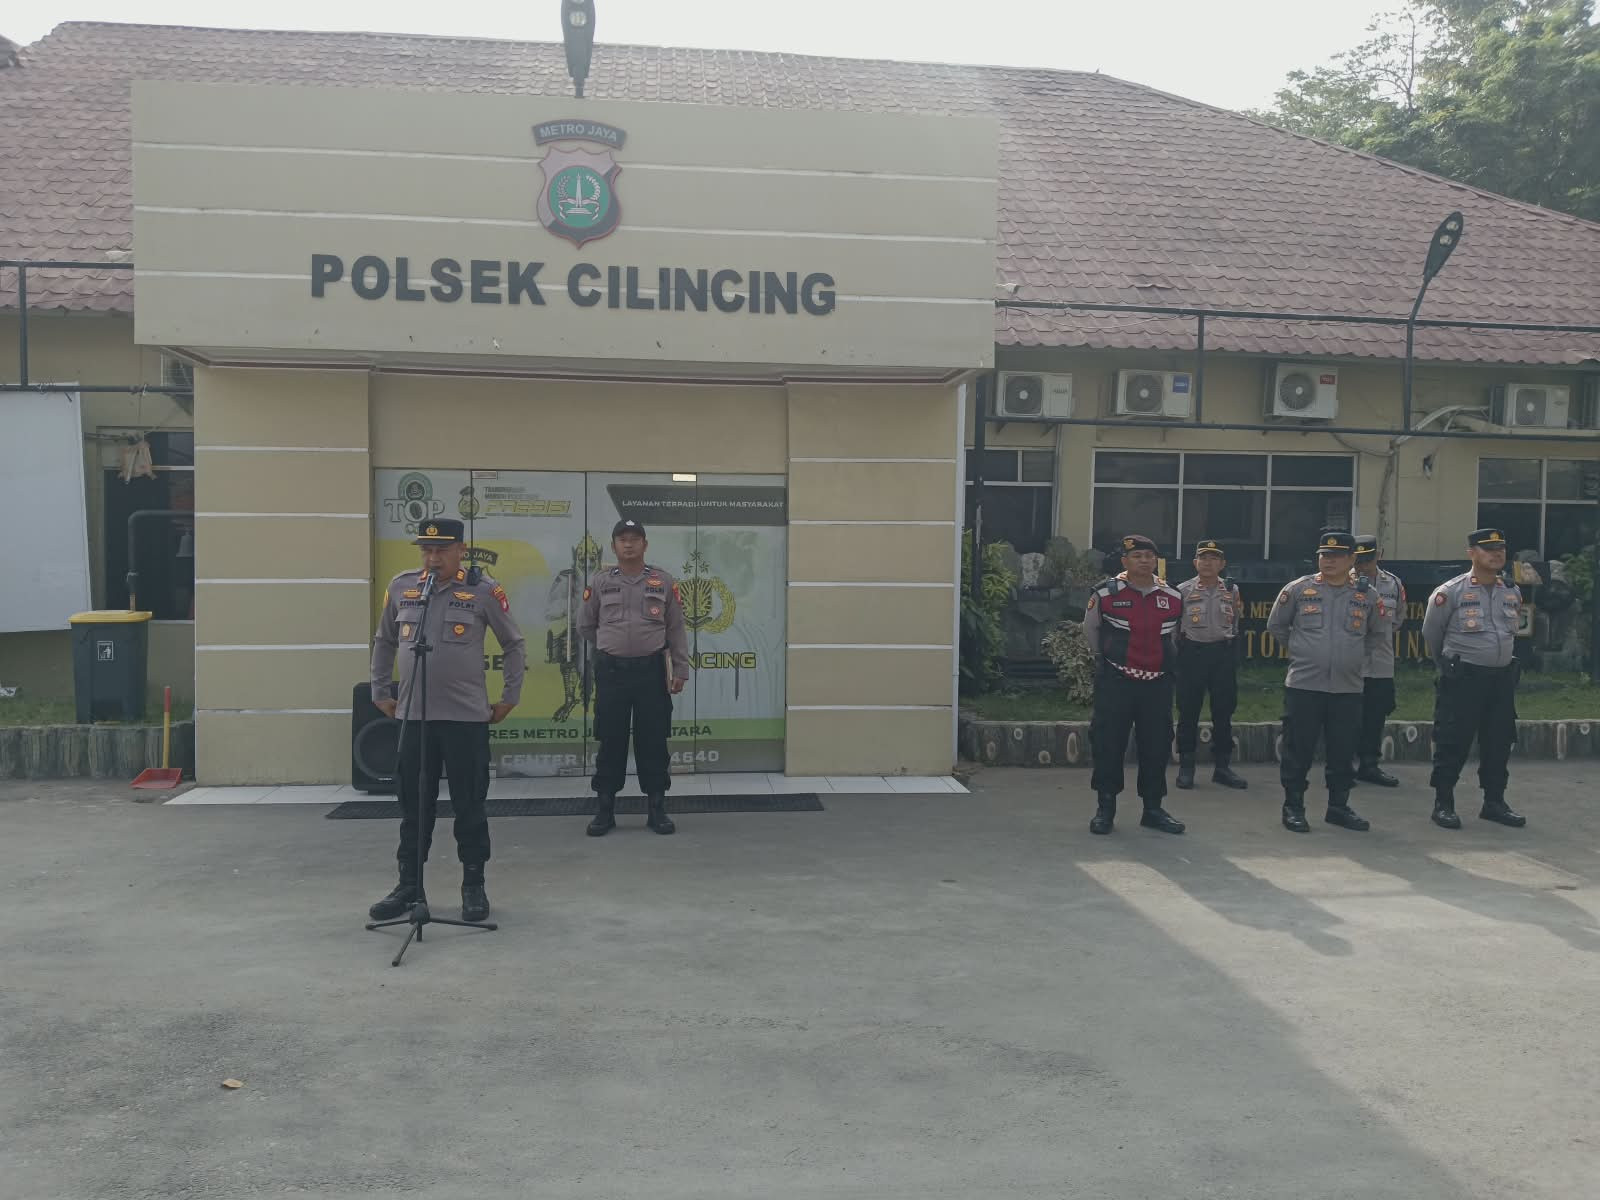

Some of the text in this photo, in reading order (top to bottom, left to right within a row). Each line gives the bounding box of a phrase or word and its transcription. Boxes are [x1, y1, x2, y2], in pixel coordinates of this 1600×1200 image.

[540, 123, 617, 142] METRO JAYA
[310, 253, 836, 316] POLSEK CILINCING
[384, 499, 445, 523] TOP
[622, 500, 660, 508] LAYANAN
[729, 501, 784, 509] MASYARAKAT
[472, 550, 494, 563] JAYA
[448, 601, 475, 609] POLRI
[687, 652, 757, 669] NCING
[488, 728, 519, 739] RES
[523, 728, 579, 739] METRO
[672, 725, 712, 737] TARA
[501, 754, 577, 766] CENTER
